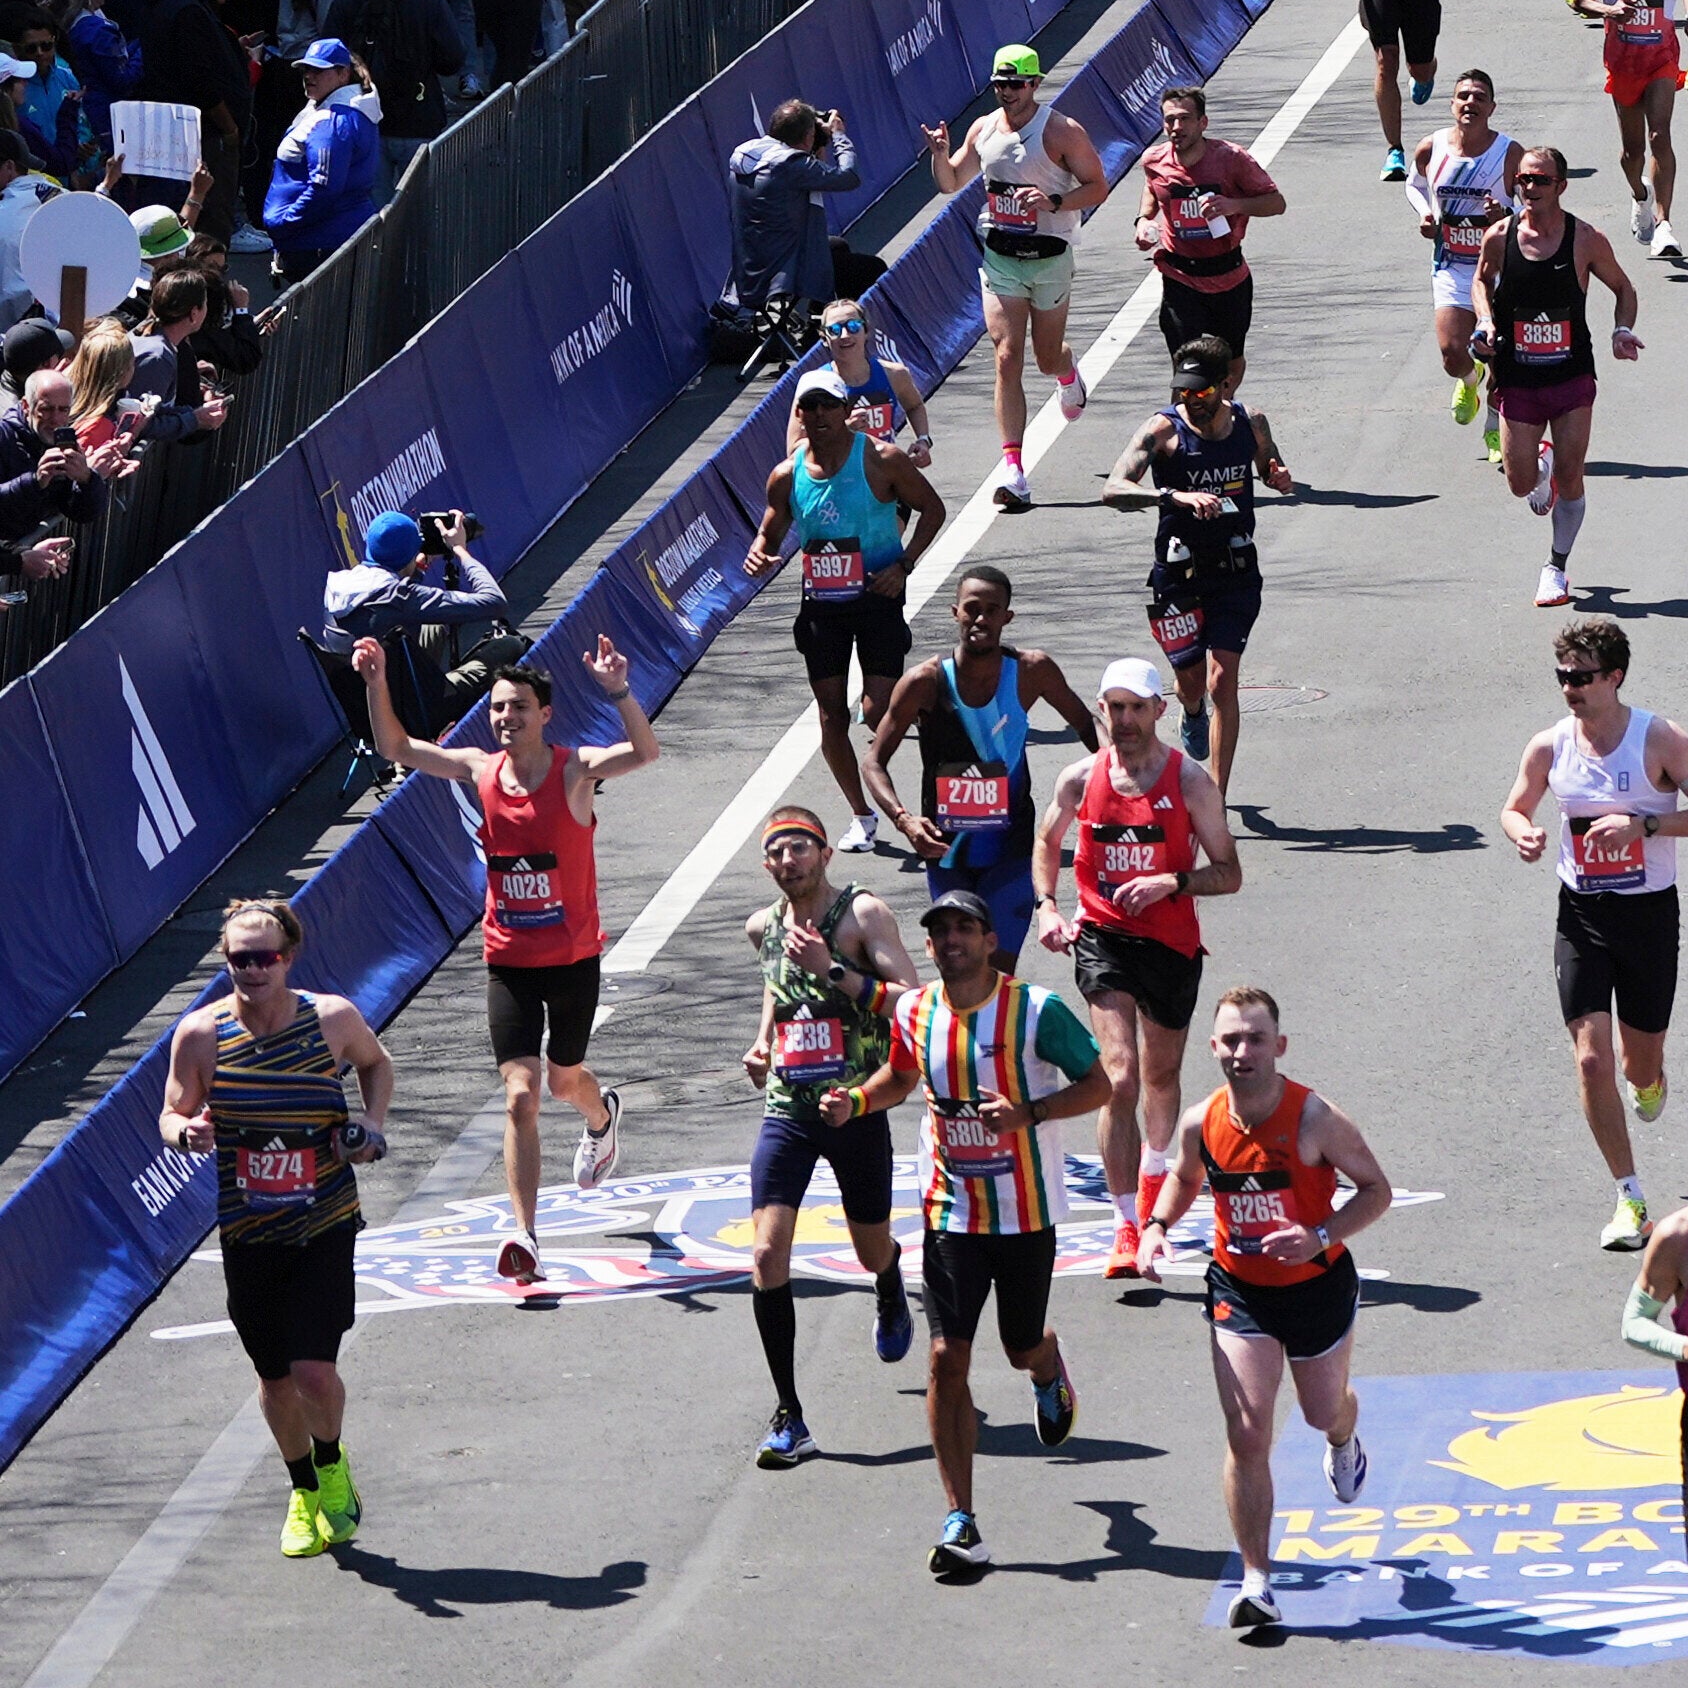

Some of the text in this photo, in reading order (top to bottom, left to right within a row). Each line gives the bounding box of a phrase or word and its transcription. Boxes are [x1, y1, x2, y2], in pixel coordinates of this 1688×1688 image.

[1522, 323, 1563, 344] 3839
[1187, 464, 1247, 485] YAMEZ
[810, 555, 853, 579] 5997
[1156, 614, 1198, 643] 1599
[947, 780, 998, 805] 2708
[1104, 845, 1156, 873] 3842
[502, 872, 552, 900] 4028
[247, 1151, 304, 1181] 5274
[131, 1155, 183, 1217] BANK
[1228, 1191, 1285, 1223] 3265
[1266, 1564, 1491, 1586] BANK
[1518, 1560, 1622, 1577] OF
